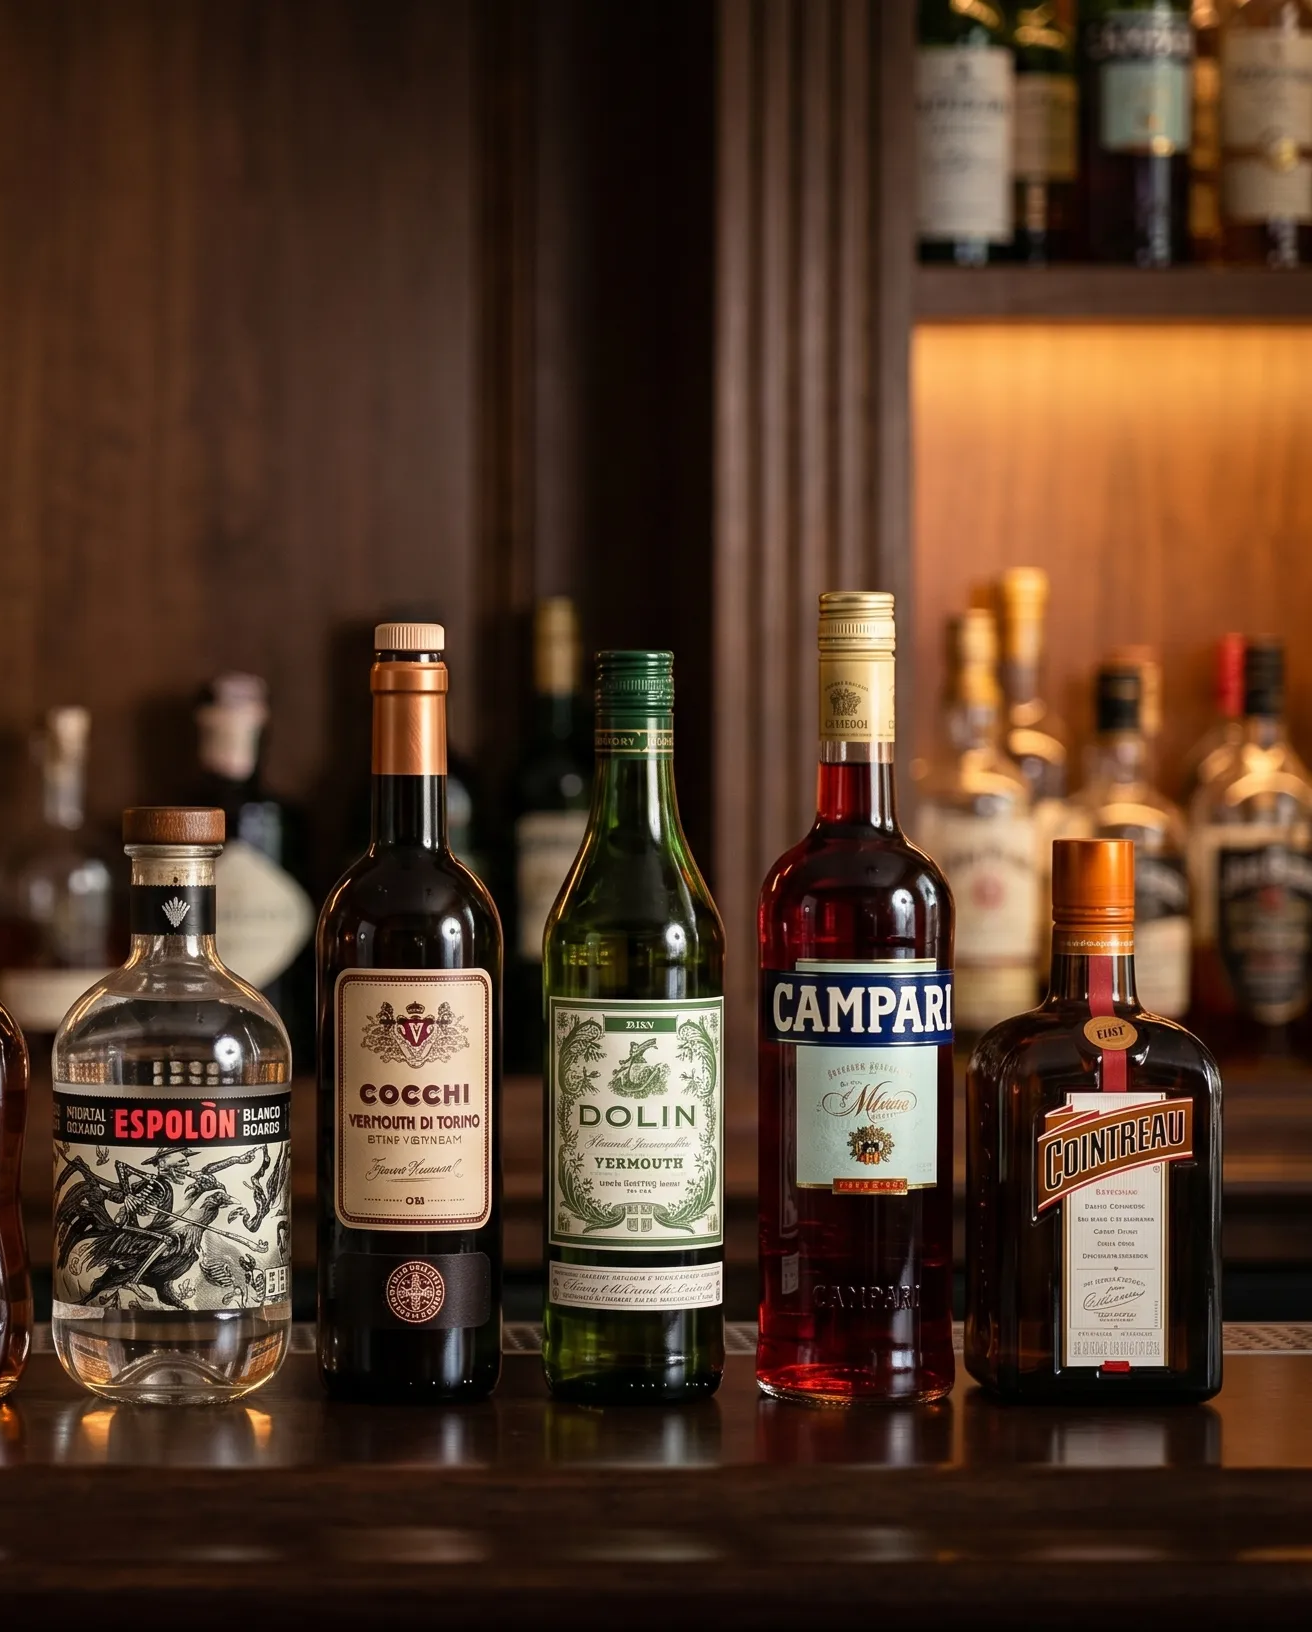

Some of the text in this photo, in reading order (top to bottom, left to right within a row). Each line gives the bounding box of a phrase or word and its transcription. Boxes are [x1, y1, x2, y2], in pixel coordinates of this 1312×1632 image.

[773, 982, 952, 1034] CAMPARI
[359, 1083, 471, 1107] COCCHI
[243, 1105, 281, 1122] BLANCO
[348, 1113, 480, 1130] VERMOUTH DI TORINO
[579, 1104, 697, 1128] DOLIN
[1044, 1109, 1186, 1192] COINTREAU
